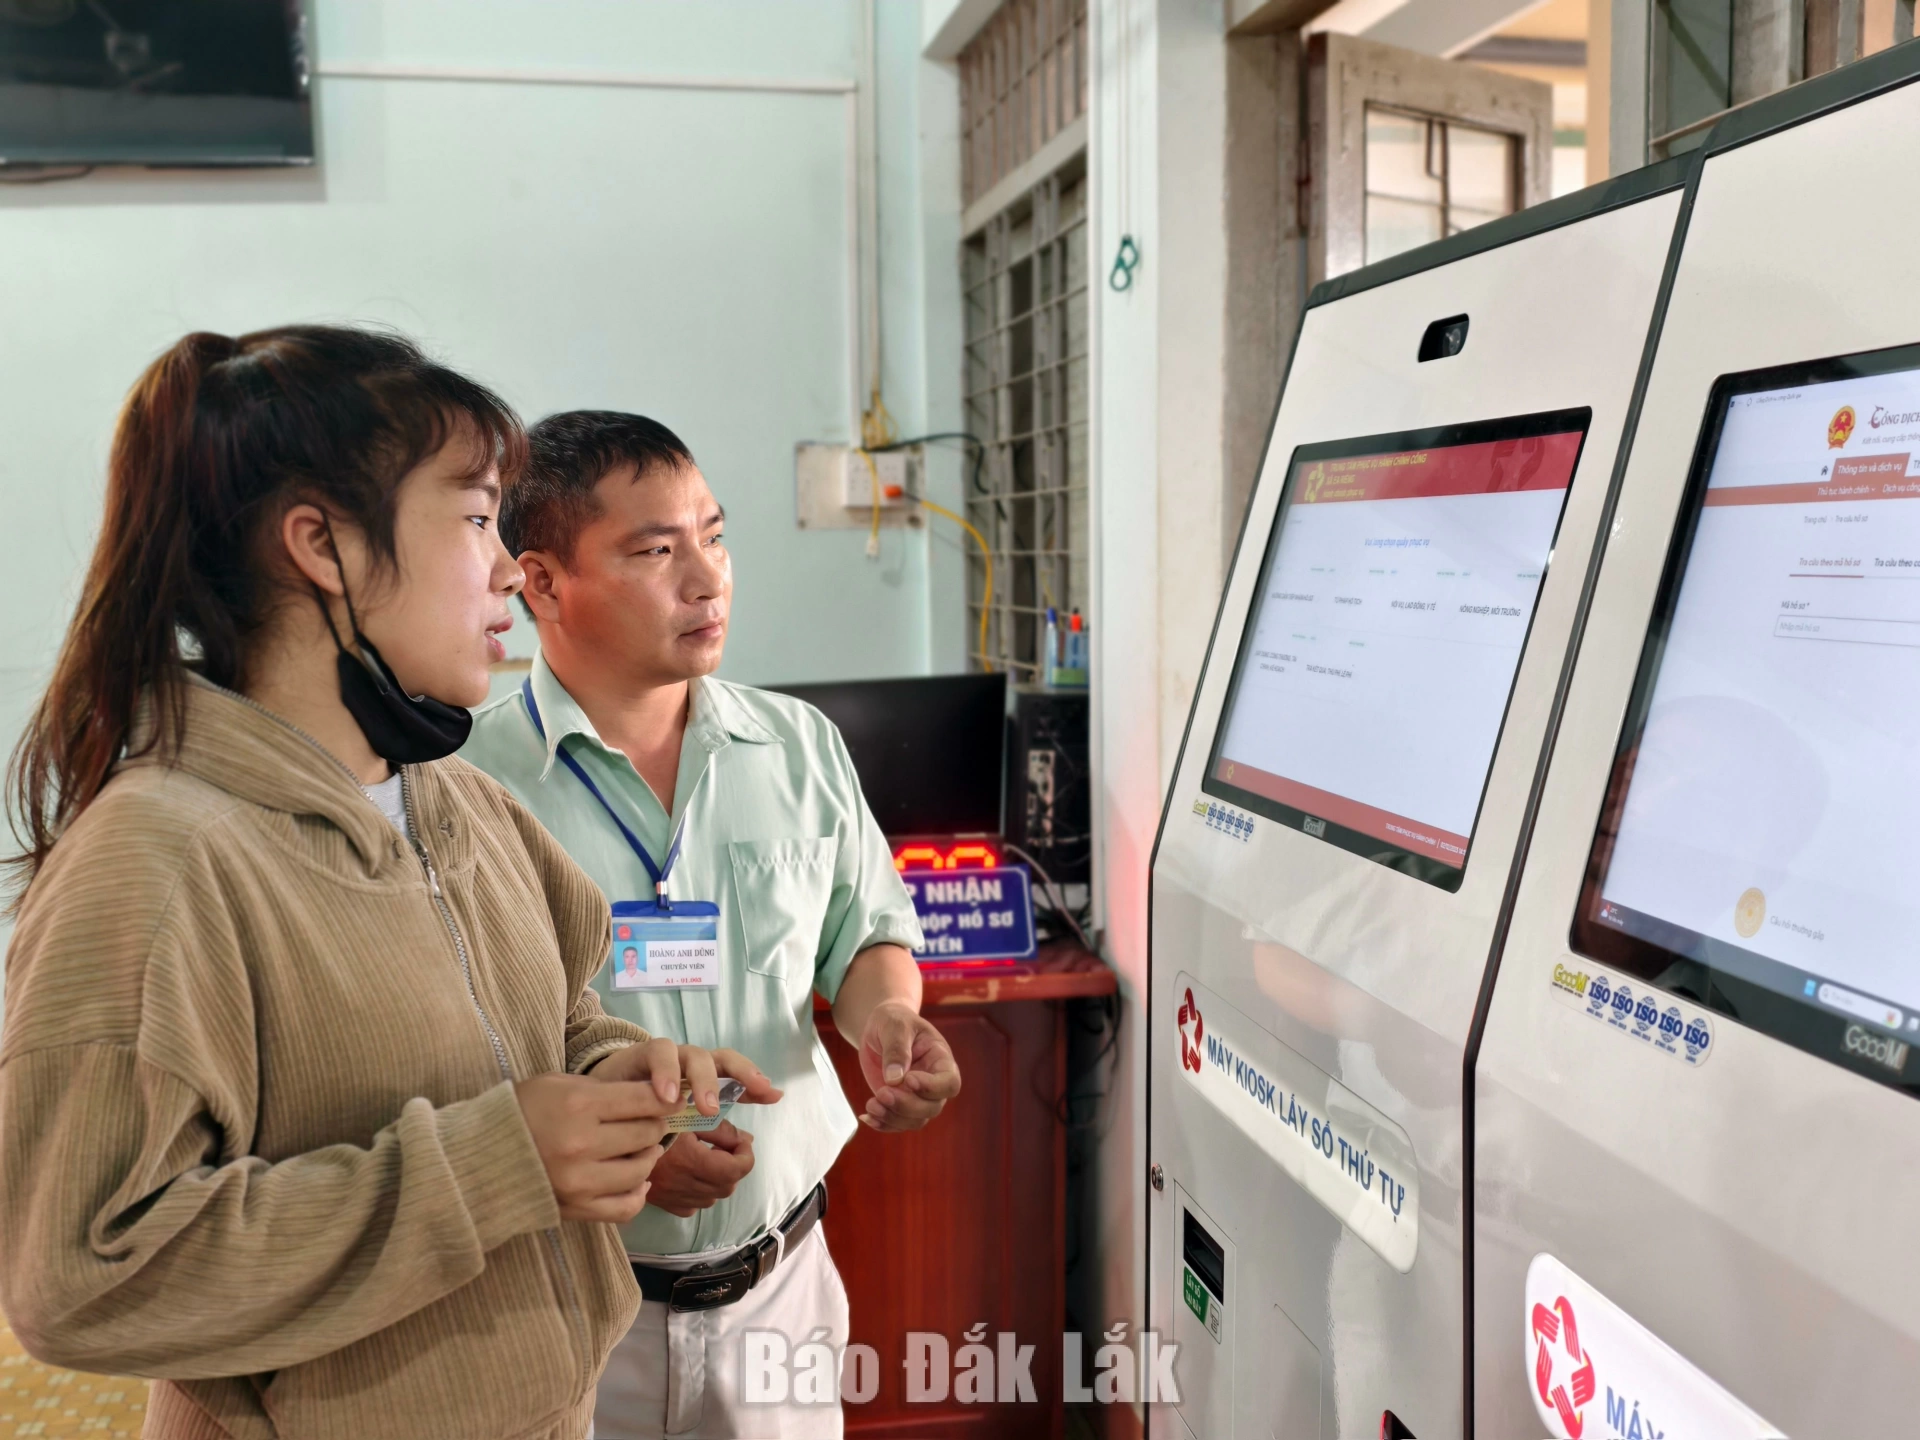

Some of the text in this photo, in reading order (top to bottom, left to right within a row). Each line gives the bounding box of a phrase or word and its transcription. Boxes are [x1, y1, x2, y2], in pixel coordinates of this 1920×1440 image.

[1208, 806, 1217, 818] ISO
[1216, 810, 1226, 822] ISO
[1225, 813, 1235, 826] ISO
[1235, 817, 1245, 830] ISO
[1244, 822, 1254, 834] ISO
[925, 876, 1002, 907] NHẬN
[958, 909, 984, 929] HỒ
[988, 910, 1014, 928] SƠ
[649, 948, 675, 958] HOÀNG
[677, 949, 693, 958] ANH
[689, 962, 705, 970] VIÊN
[1588, 981, 1611, 1003] ISO
[1611, 991, 1634, 1014] ISO
[1634, 1002, 1658, 1026] ISO
[1658, 1013, 1683, 1037] ISO
[1683, 1024, 1709, 1049] ISO
[1207, 1034, 1406, 1223] MÁY KIOSK LẤY SỐ THỨ TỰ
